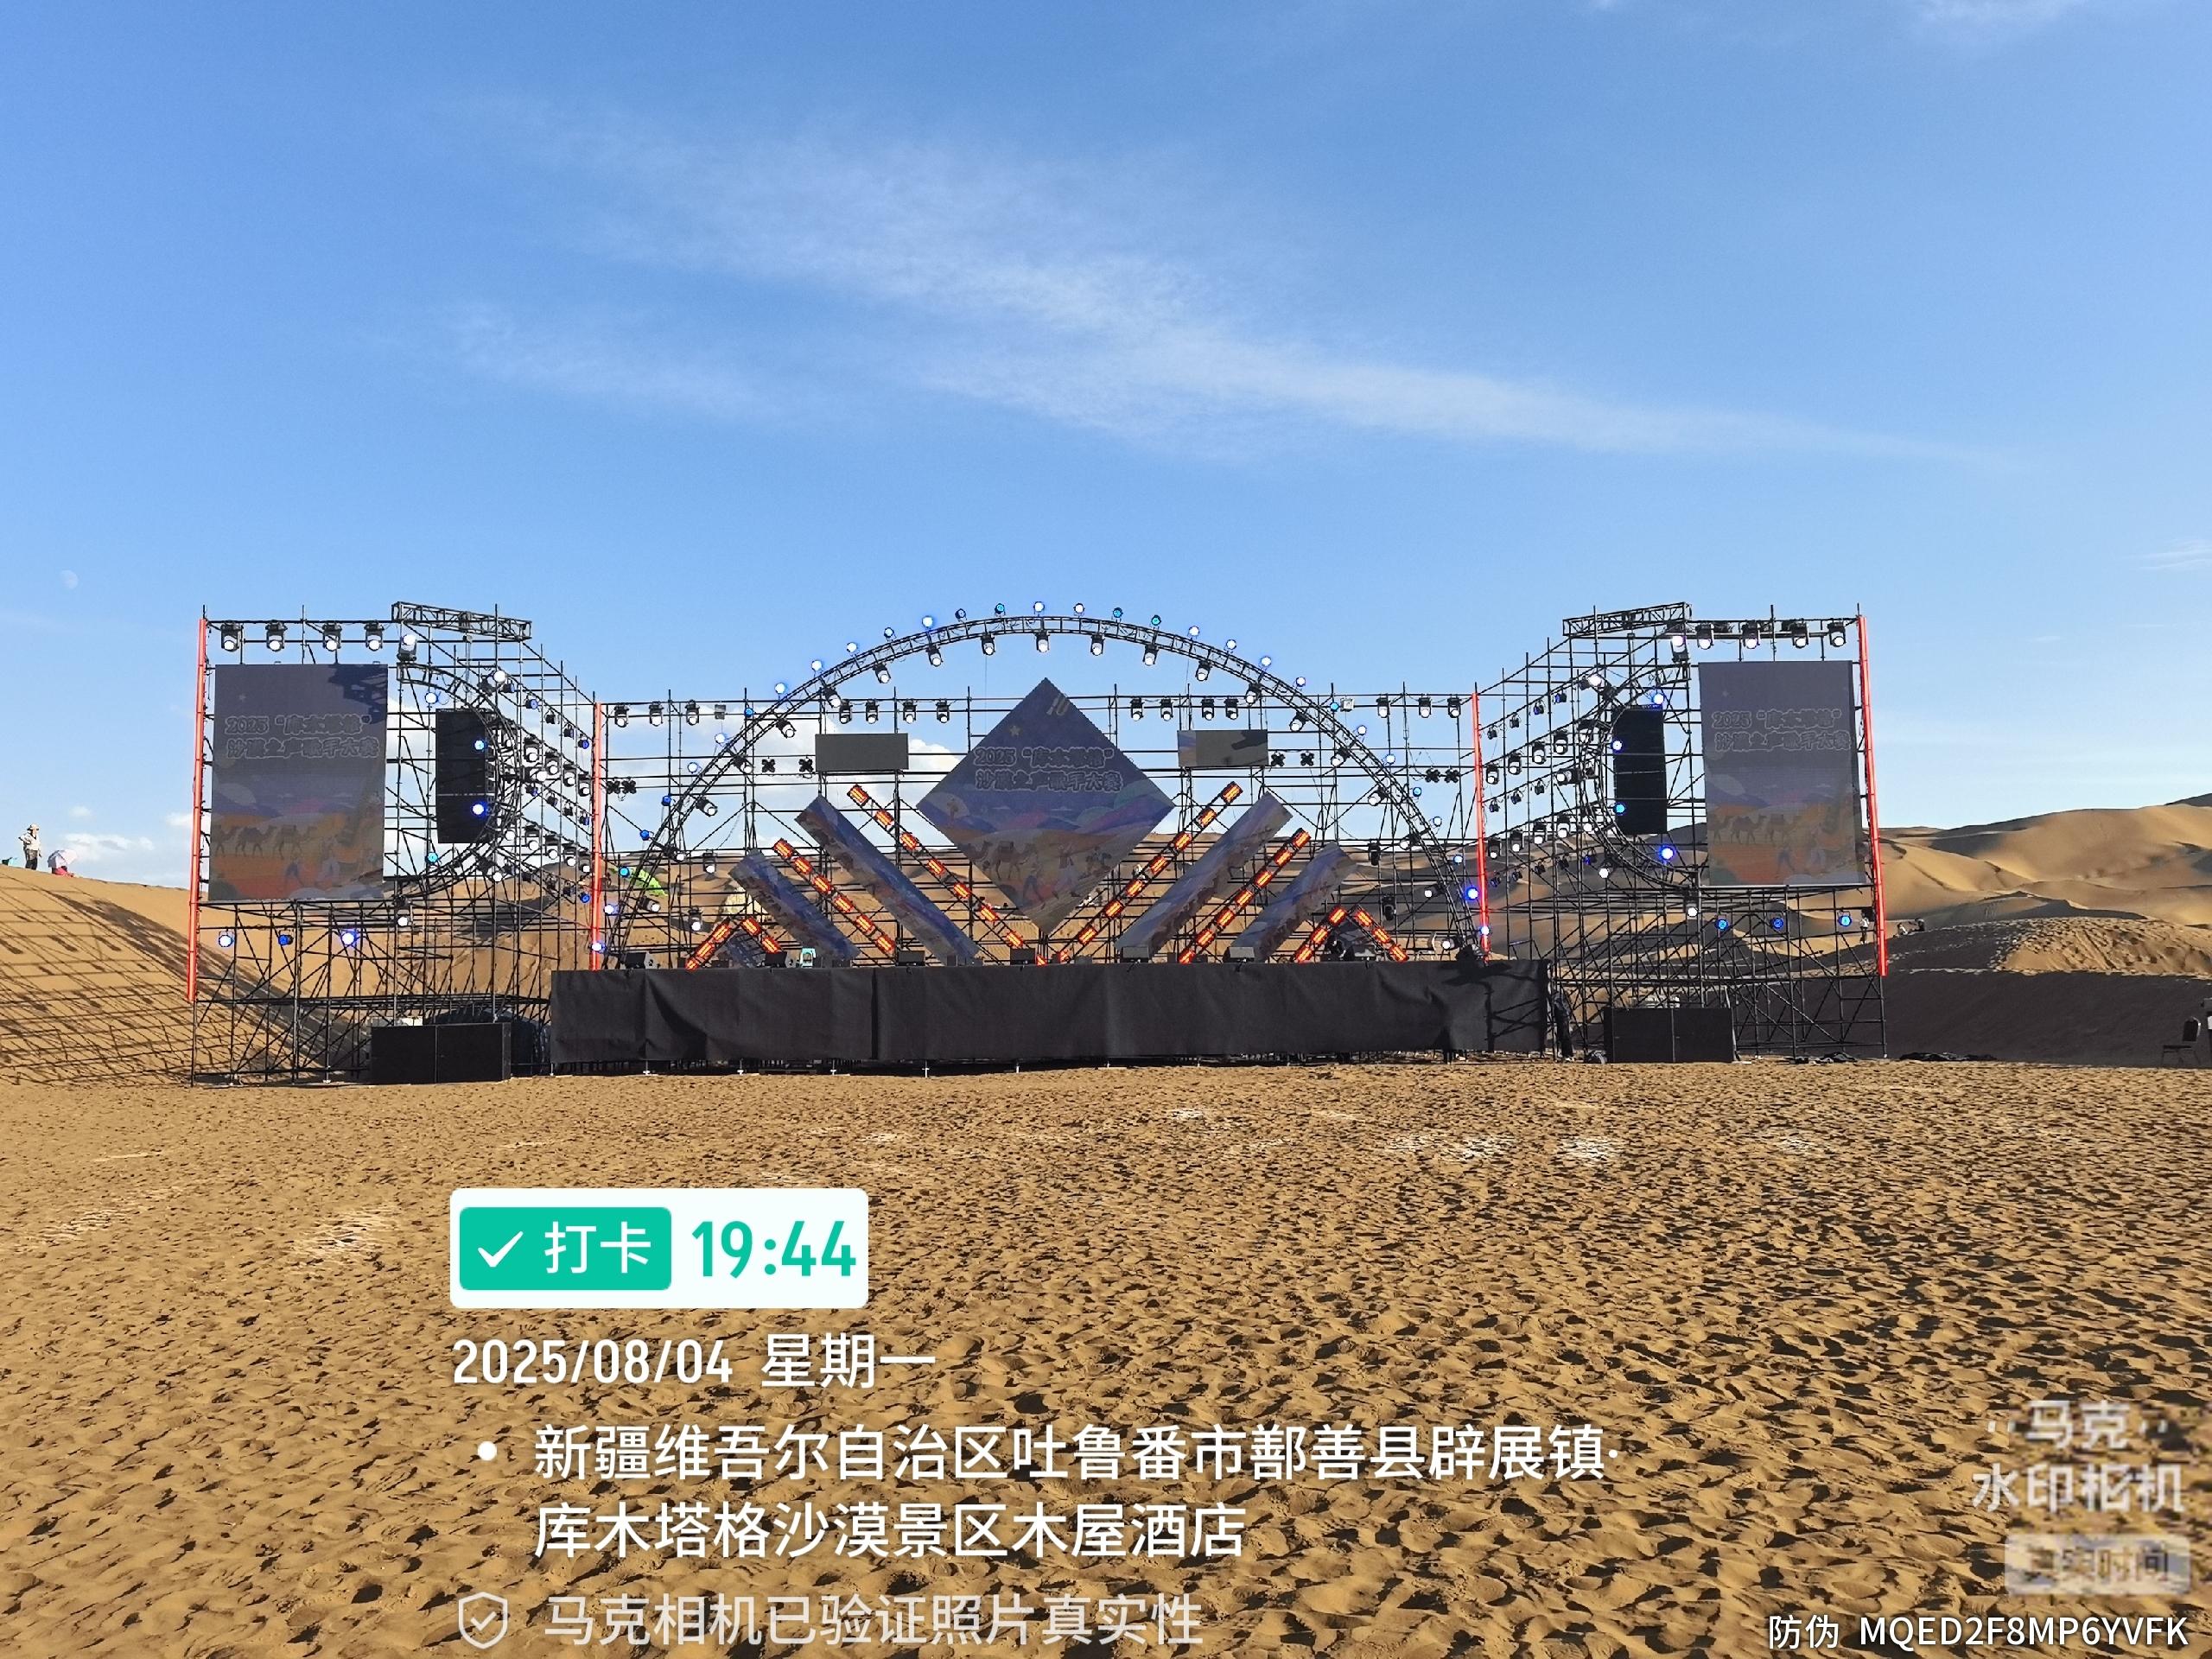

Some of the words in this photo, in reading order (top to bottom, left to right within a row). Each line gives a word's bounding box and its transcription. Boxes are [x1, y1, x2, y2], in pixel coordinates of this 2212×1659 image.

[225, 715, 270, 734] 2025
[1712, 710, 1752, 729] 2025
[974, 747, 1017, 766] 2025
